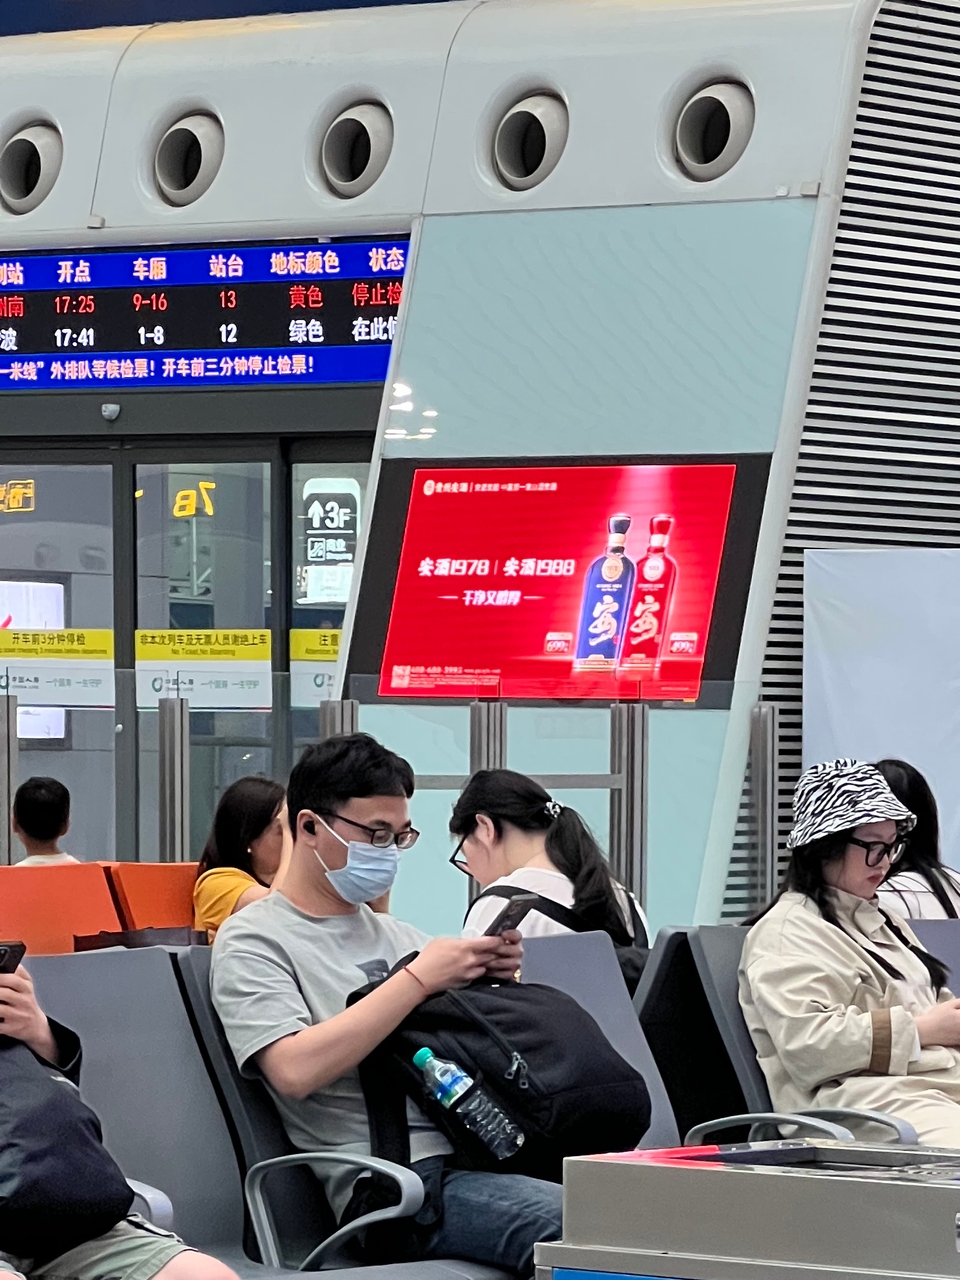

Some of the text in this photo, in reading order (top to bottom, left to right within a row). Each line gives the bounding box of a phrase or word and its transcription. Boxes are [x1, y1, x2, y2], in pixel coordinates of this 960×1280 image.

[57, 259, 91, 283] 开点
[133, 257, 167, 281] 车厢
[209, 254, 244, 278] 站台
[269, 250, 341, 275] 地标颜色
[368, 247, 404, 272] 状态
[54, 295, 95, 314] 17:25
[133, 292, 168, 313] 9-16
[219, 290, 237, 308] 13
[288, 285, 324, 309] 黄色
[351, 282, 403, 307] 停止检
[0, 327, 18, 351] 波
[54, 327, 95, 347] 17:41
[137, 327, 165, 346] 1-8
[218, 324, 238, 343] 12
[288, 319, 325, 344] 绿色
[324, 501, 351, 529] 3F
[417, 556, 575, 577] 安酒1978 安酒1988
[12, 632, 86, 646] 开车前3分钟停检
